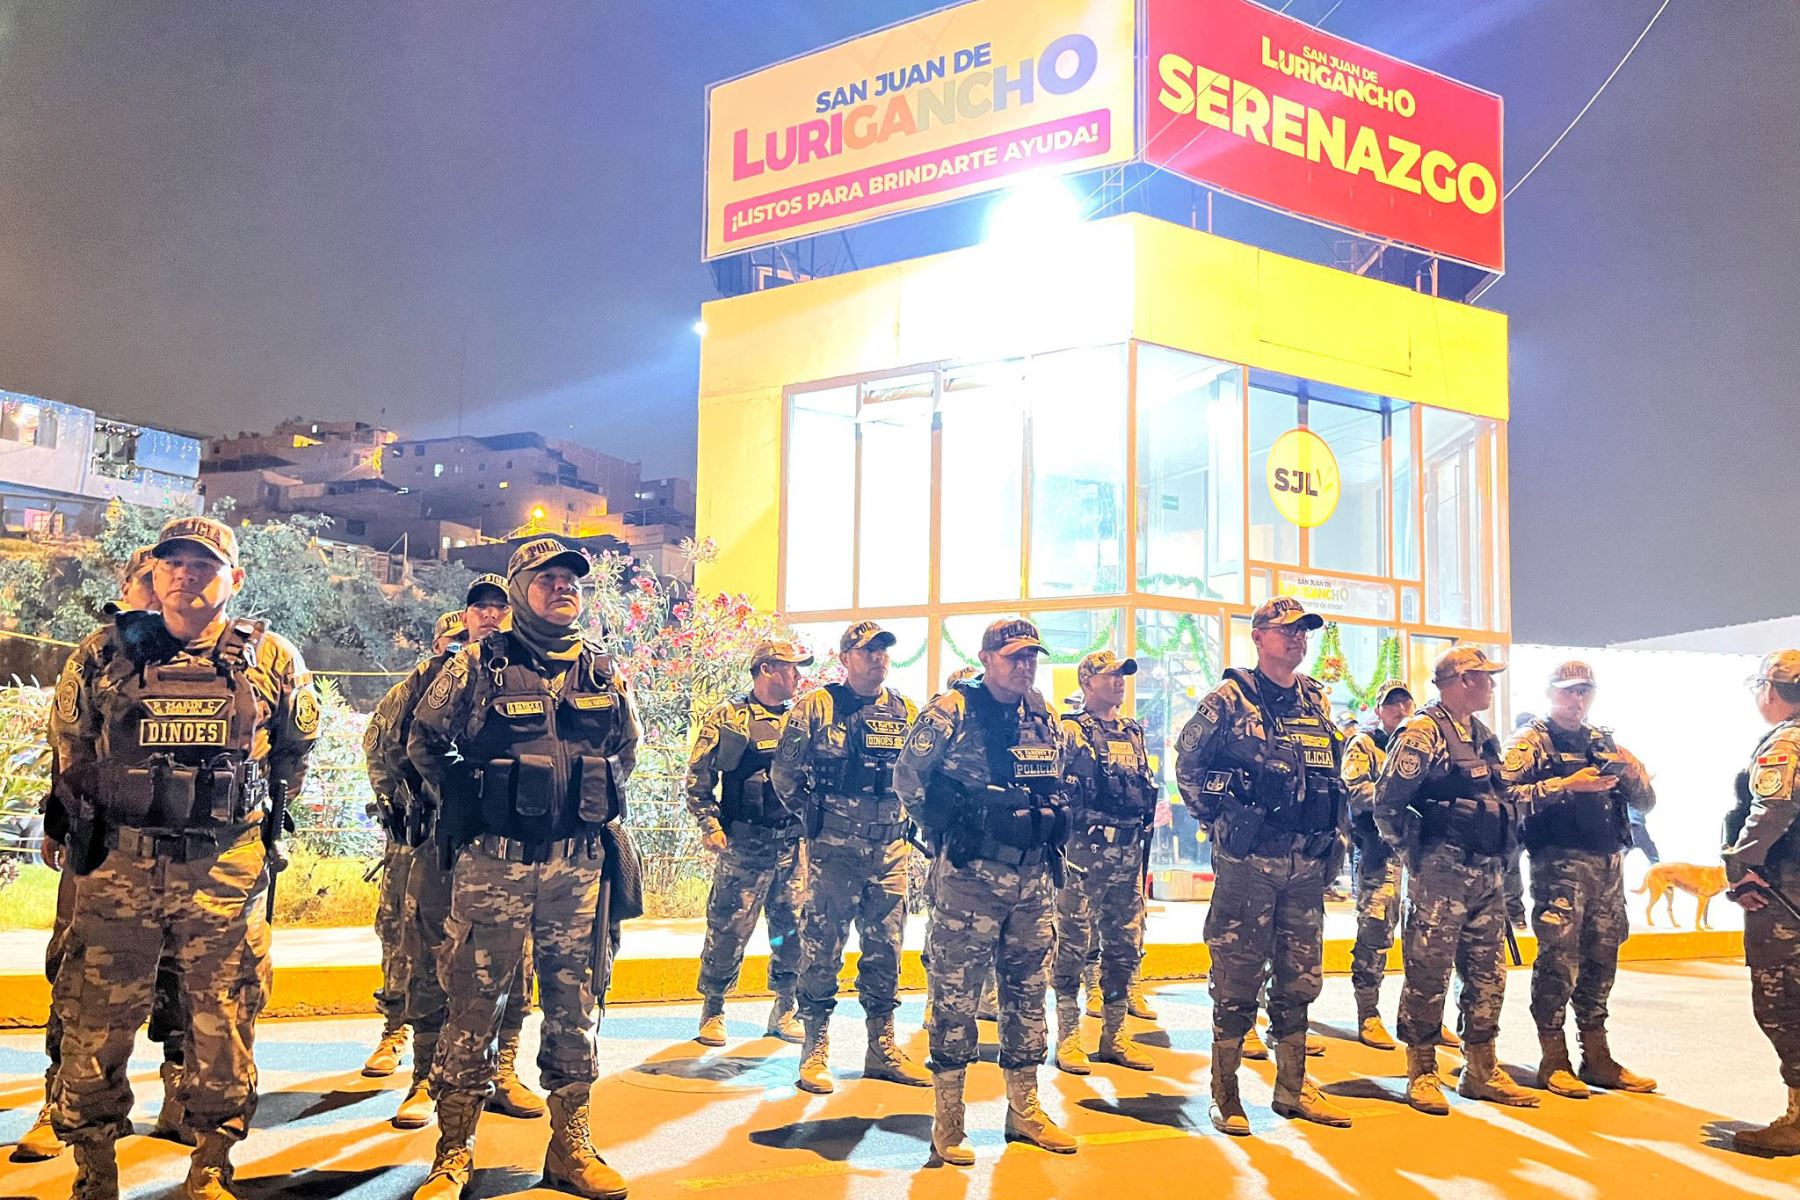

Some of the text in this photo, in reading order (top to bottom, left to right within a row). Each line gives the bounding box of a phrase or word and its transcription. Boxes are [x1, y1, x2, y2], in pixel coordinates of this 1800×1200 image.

[815, 42, 992, 113] SAN JUAN DE
[1261, 35, 1416, 118] LURIGANCHO
[1302, 45, 1378, 84] SAN JUAN DE
[733, 34, 1098, 181] LURIGANCHO
[1158, 53, 1497, 215] SERENAZGO
[731, 122, 1100, 232] ¡LISTOS PARA BRINDARTE AYUDA!
[1274, 467, 1319, 497] SJL
[1298, 578, 1310, 586] SAN
[1311, 579, 1324, 587] JUAN
[148, 722, 217, 742] DINOES
